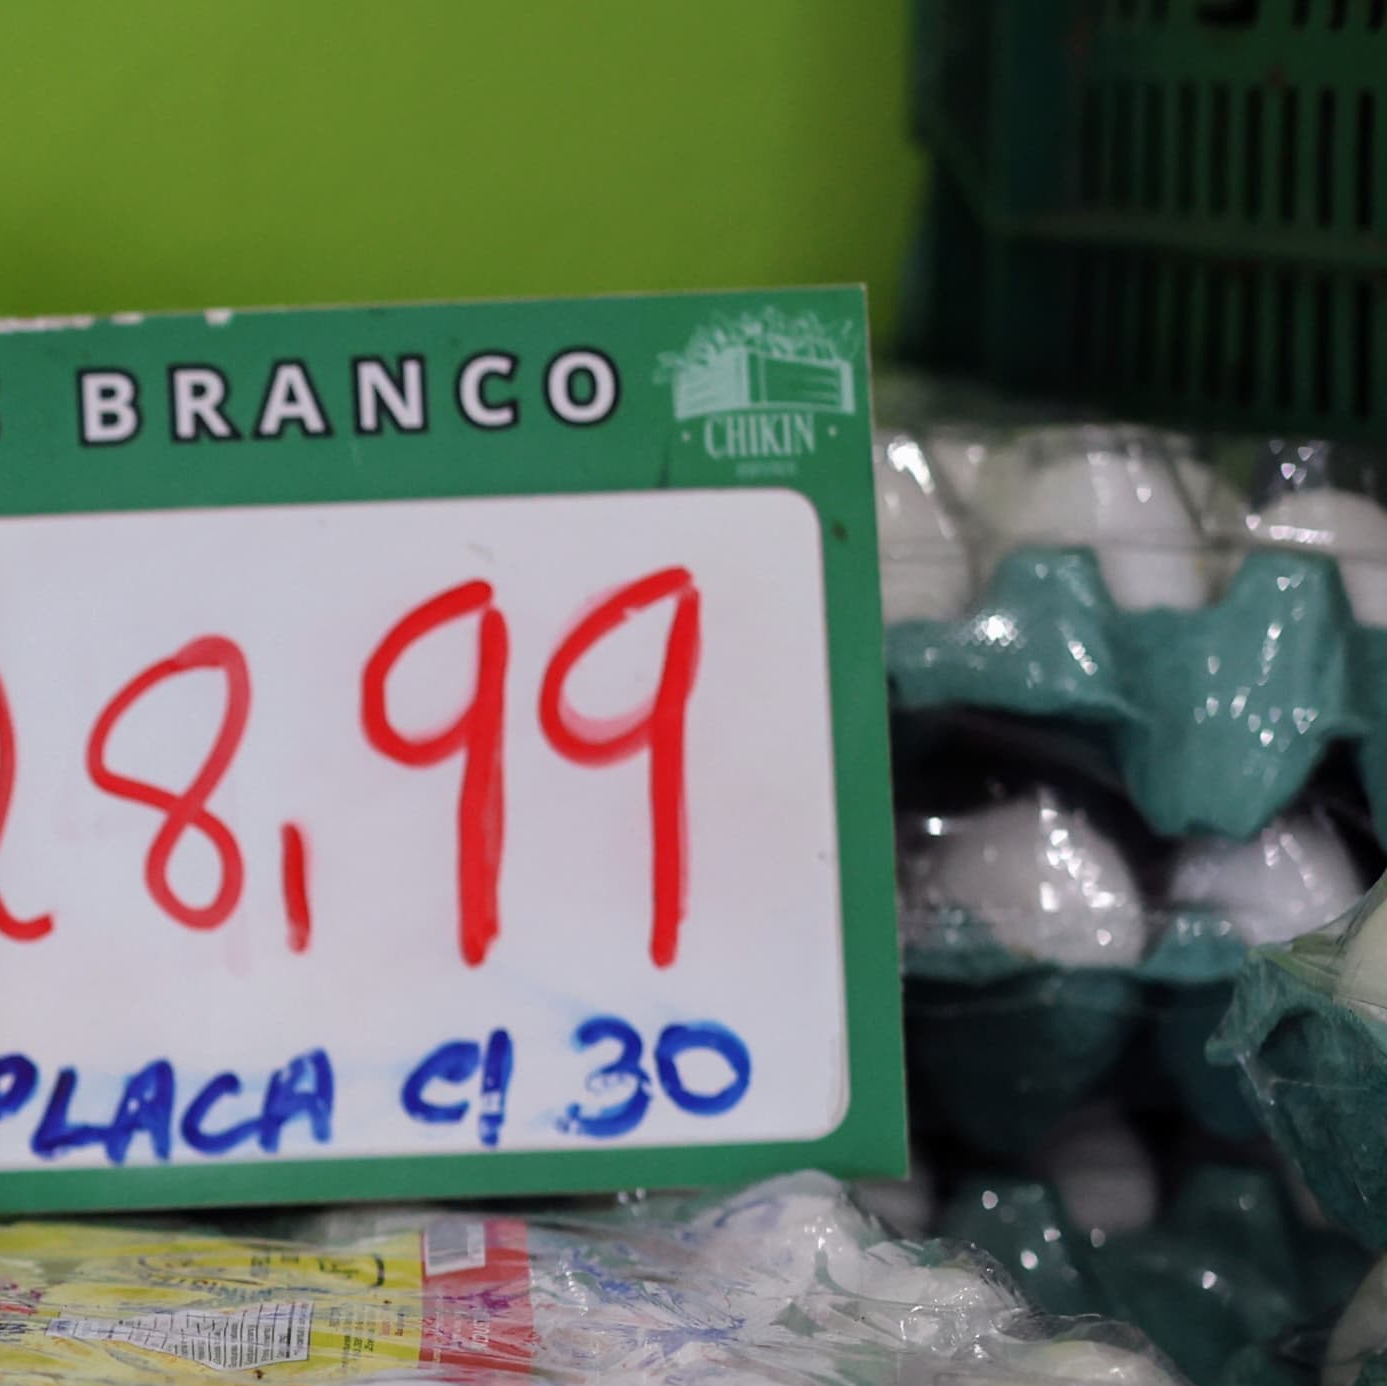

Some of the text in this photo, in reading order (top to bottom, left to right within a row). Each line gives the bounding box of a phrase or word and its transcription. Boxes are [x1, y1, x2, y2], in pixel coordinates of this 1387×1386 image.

[75, 345, 623, 448] BRANCO
[704, 411, 815, 459] CHIKIN
[557, 1014, 752, 1139] 30
